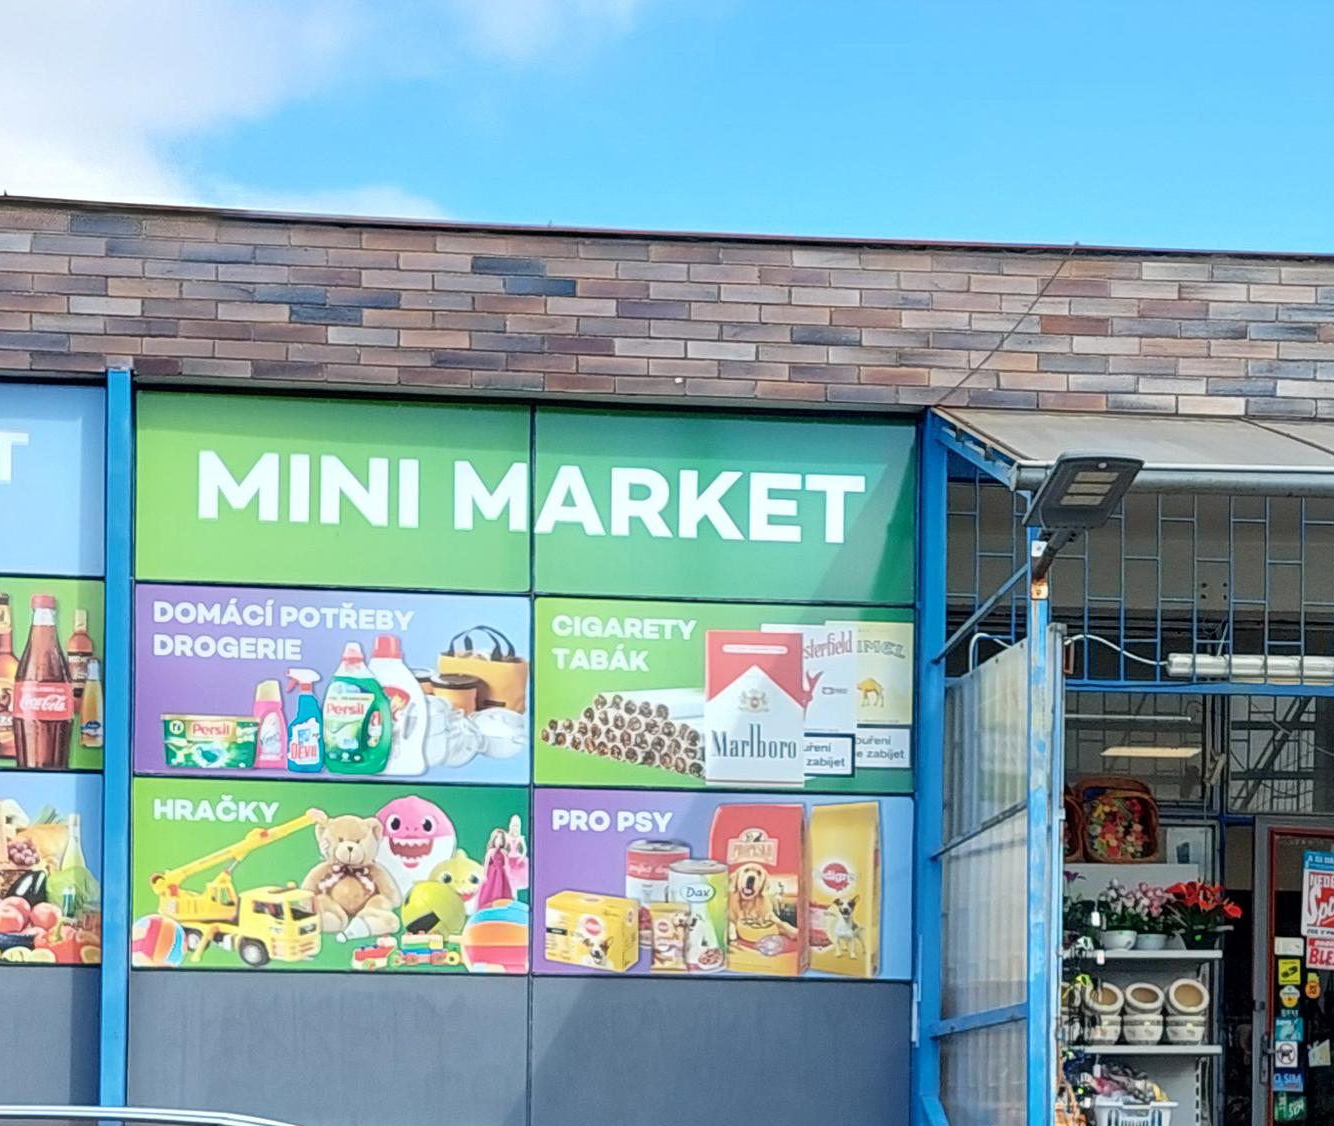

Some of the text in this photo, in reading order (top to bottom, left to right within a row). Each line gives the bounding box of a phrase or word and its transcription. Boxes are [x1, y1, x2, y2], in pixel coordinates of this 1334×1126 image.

[197, 449, 867, 545] MINI MARKET
[153, 598, 414, 633] DOMÁCÍ POTŘEBY
[552, 615, 696, 645] CIGARETY
[153, 634, 302, 661] DROGERIE
[552, 643, 649, 673] TABÁK
[803, 629, 853, 660] sterfield
[326, 702, 366, 716] Persil
[191, 723, 230, 736] Persil
[711, 724, 797, 759] Marlboro
[153, 795, 279, 824] HRAČKY
[552, 809, 673, 833] PRO PSY
[686, 885, 709, 899] Dax
